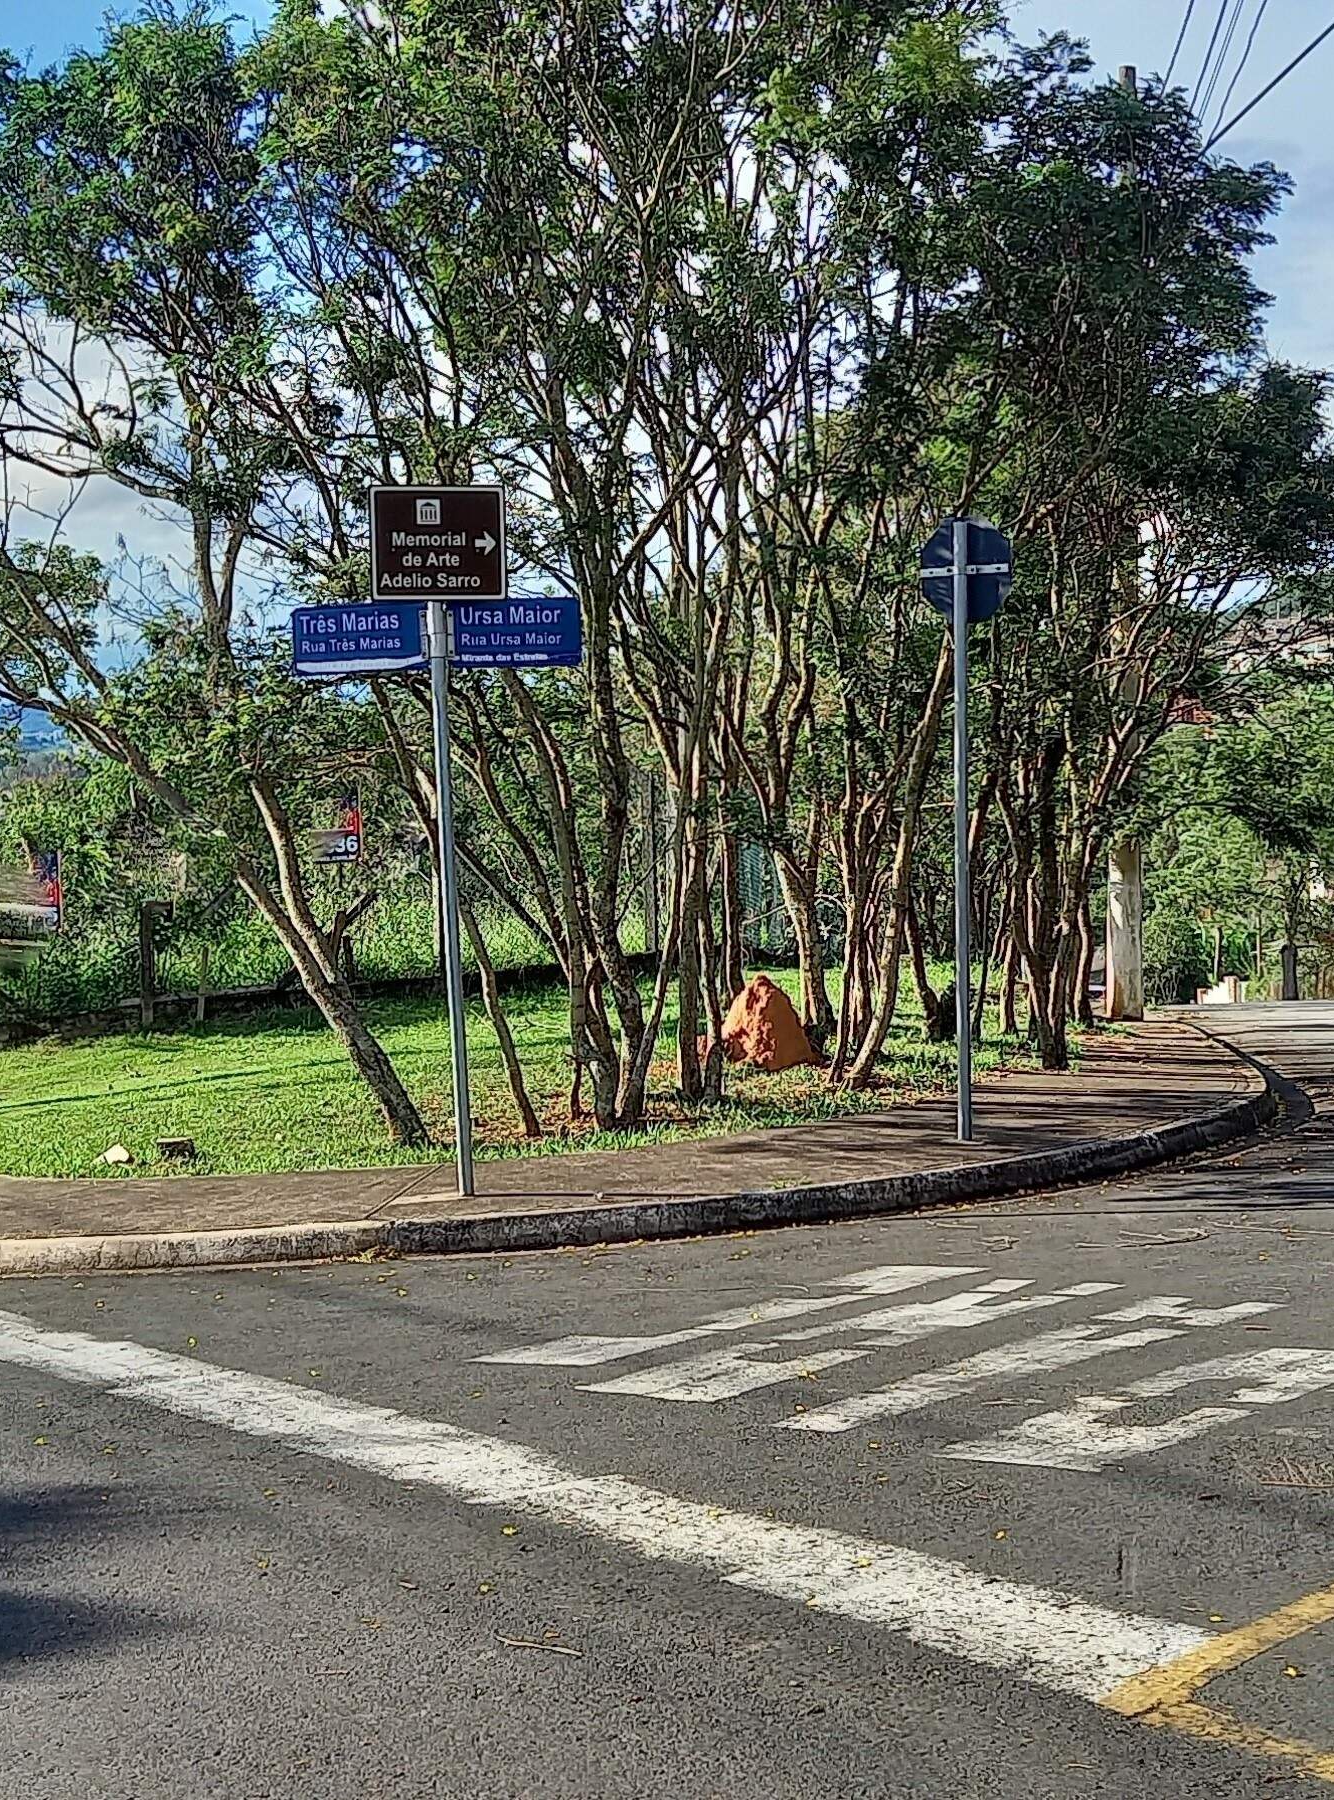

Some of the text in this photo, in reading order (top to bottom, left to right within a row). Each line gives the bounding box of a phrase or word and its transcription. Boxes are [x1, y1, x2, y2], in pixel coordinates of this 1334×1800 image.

[391, 531, 466, 547] Memorial
[402, 551, 460, 567] de Arte
[380, 573, 481, 588] Adelio Sarro
[299, 611, 399, 634] Três Marias
[460, 605, 561, 625] Ursa Maior
[301, 637, 401, 654] Rua Três Marias
[461, 632, 562, 646] Rua Ursa Maior
[461, 654, 494, 662] Mirante
[495, 653, 512, 662] das
